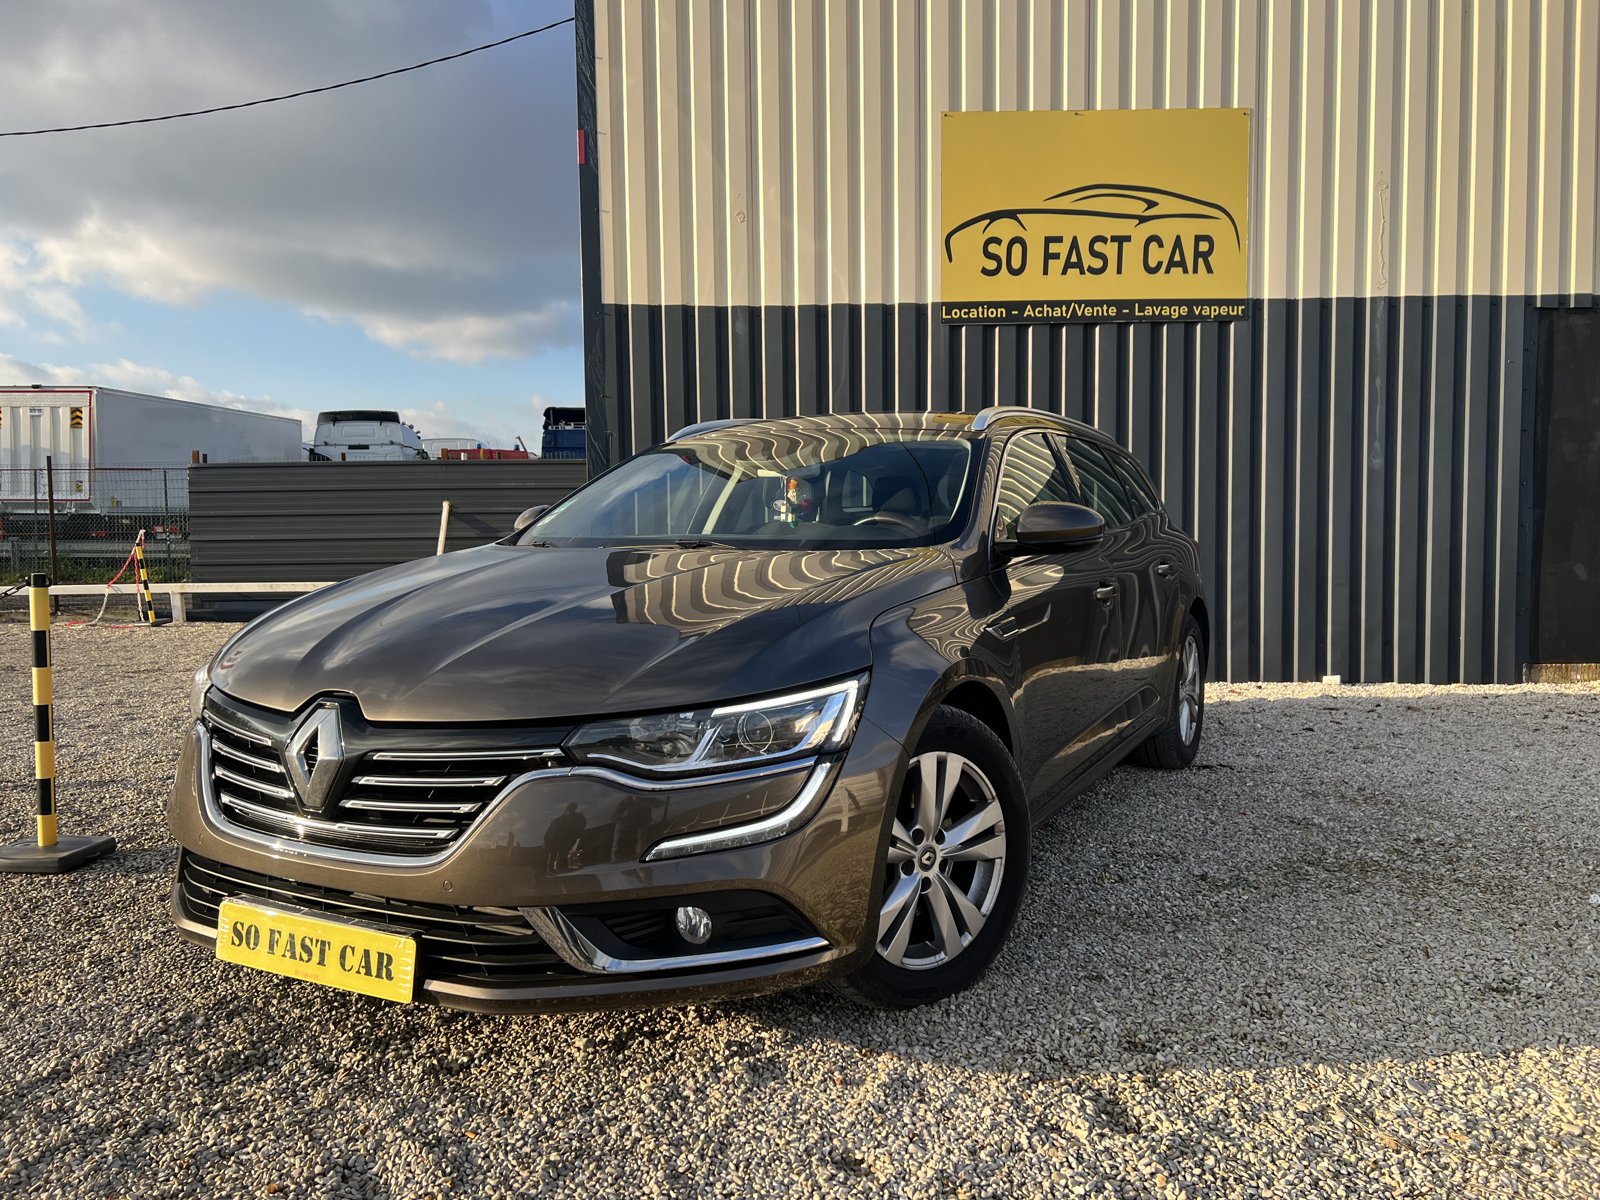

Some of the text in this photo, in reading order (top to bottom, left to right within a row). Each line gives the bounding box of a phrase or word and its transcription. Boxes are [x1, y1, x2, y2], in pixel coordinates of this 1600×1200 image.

[980, 234, 1215, 277] SO FAST CAR
[942, 305, 1006, 319] Location
[1023, 303, 1117, 319] Achat/Vente
[1135, 303, 1188, 318] Lavage
[1193, 304, 1245, 318] vapeur
[230, 921, 394, 981] SO FAST CAR
